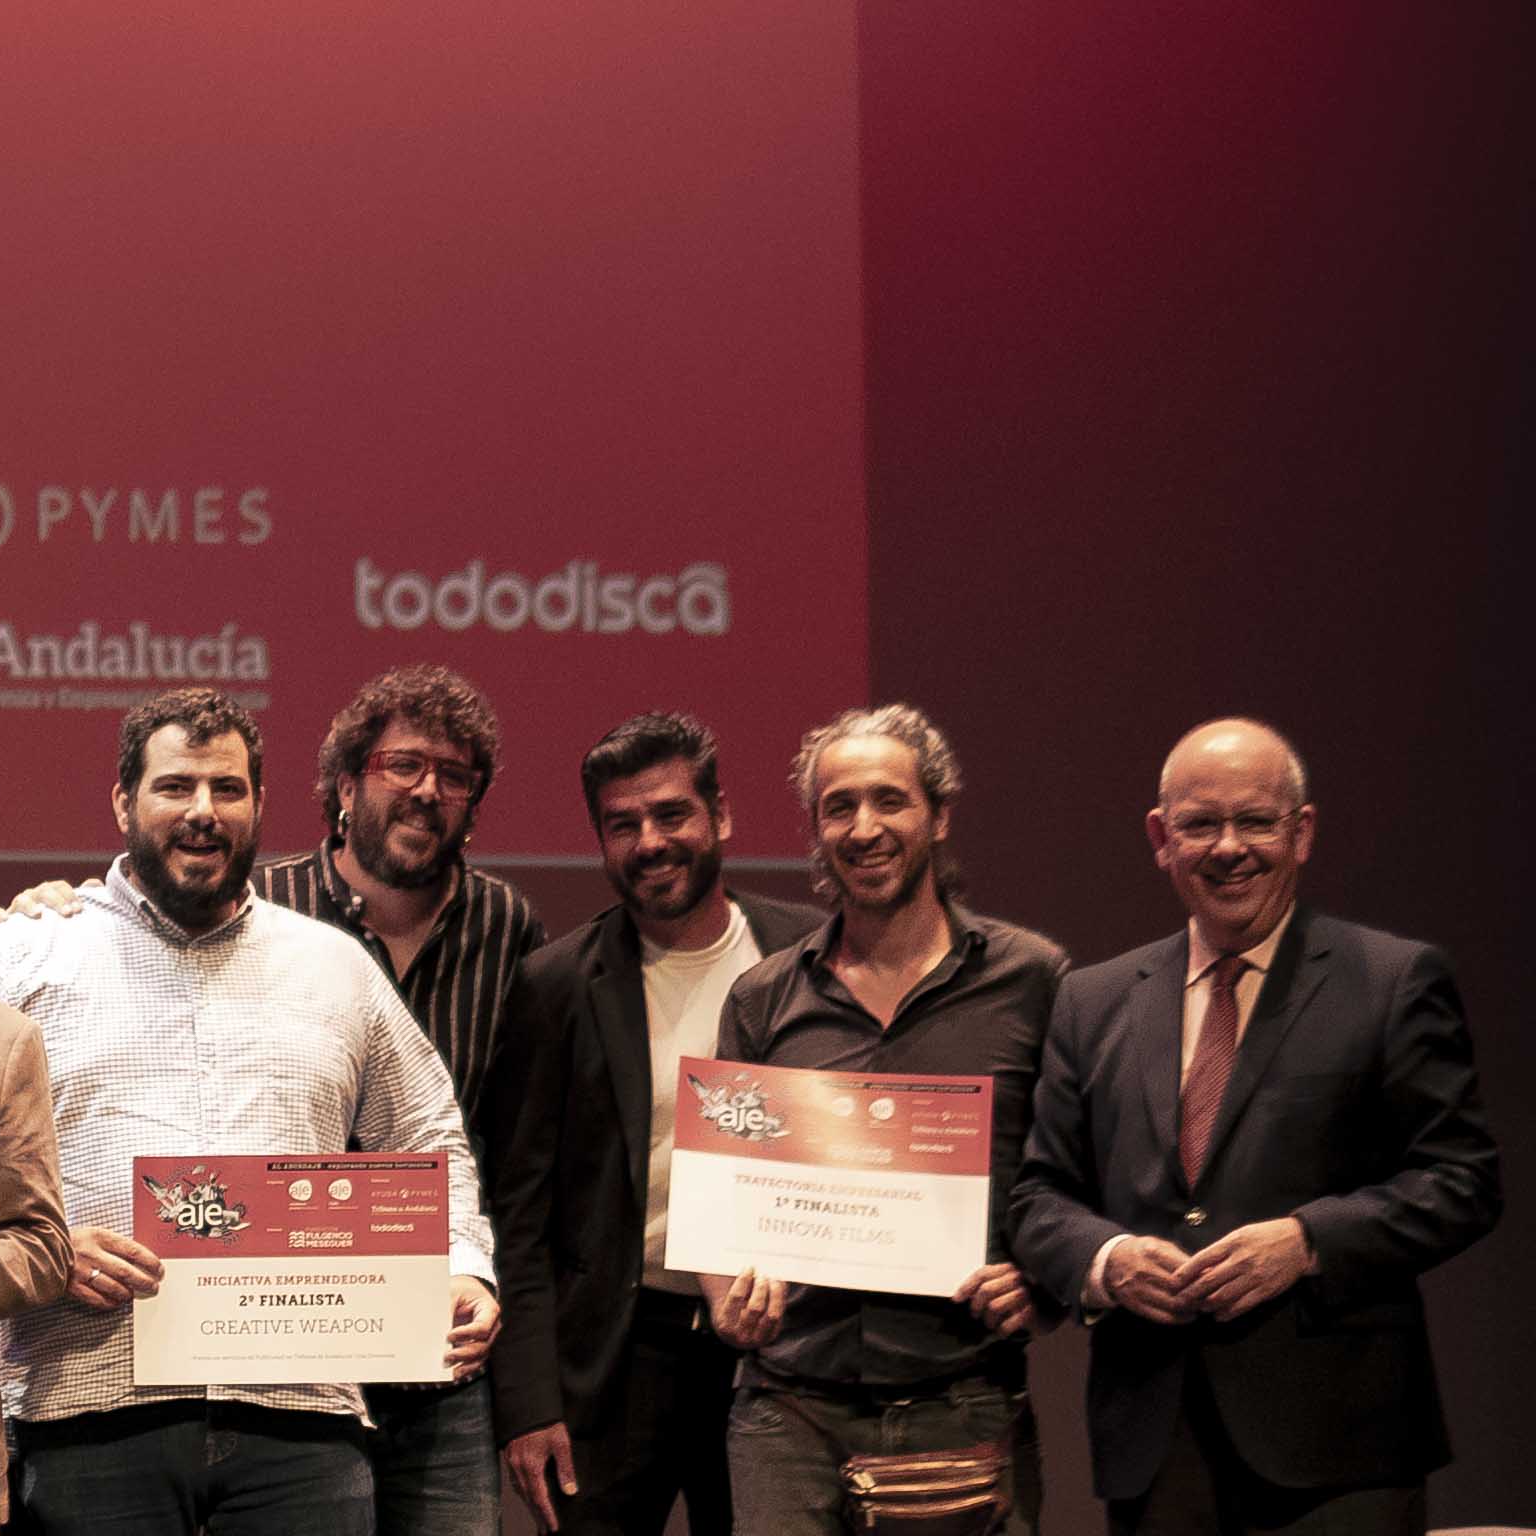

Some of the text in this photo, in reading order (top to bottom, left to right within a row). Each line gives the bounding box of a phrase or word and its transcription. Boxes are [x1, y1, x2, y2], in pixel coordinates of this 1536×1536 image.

[38, 486, 276, 546] PYMES
[717, 1105, 765, 1132] aje
[177, 1200, 224, 1230] aje
[792, 1199, 881, 1218] FINALISTA
[197, 1274, 387, 1287] INICIATIVA EMPRENDEDORA
[259, 1293, 346, 1307] FINALISTA
[199, 1317, 385, 1336] CREATIVE WEAPON
